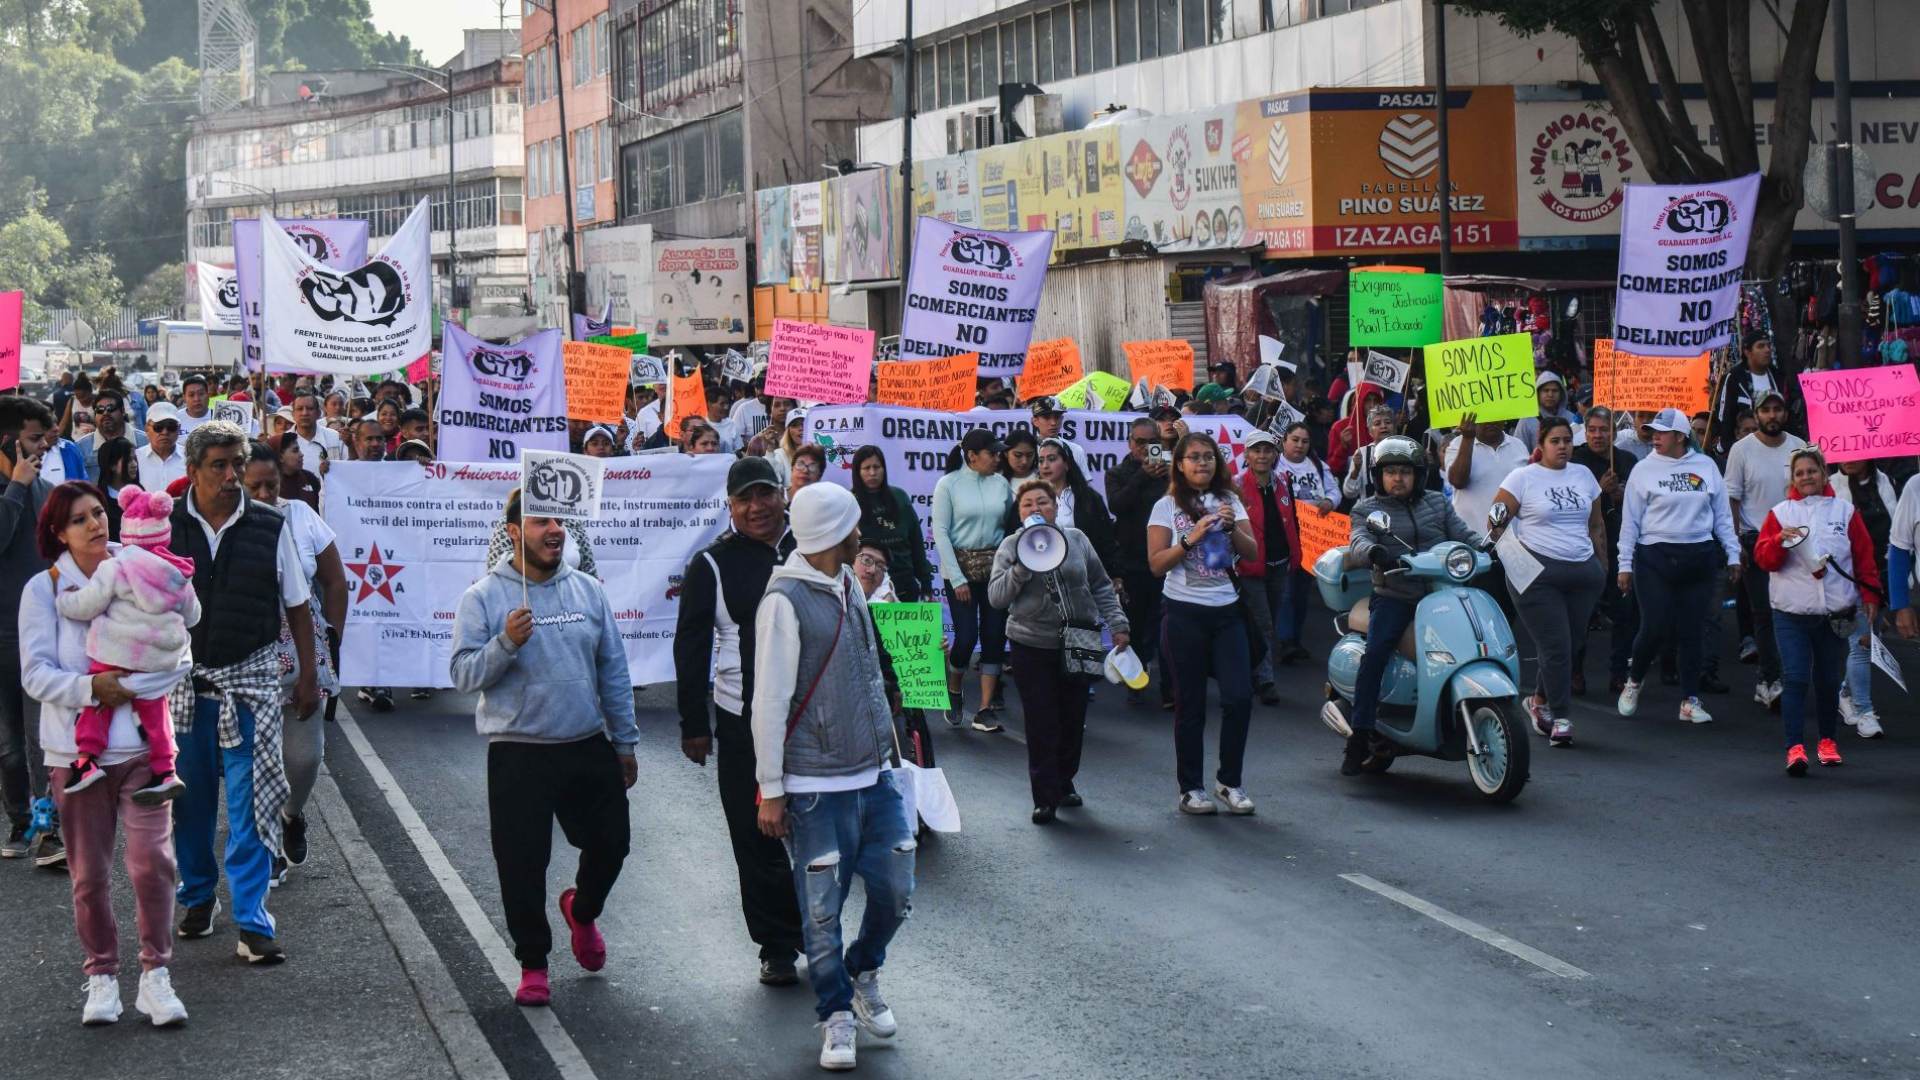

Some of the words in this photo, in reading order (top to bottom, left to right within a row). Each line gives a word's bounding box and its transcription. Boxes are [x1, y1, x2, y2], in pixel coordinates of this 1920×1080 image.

[1267, 99, 1290, 114] PASAJE
[1530, 112, 1633, 175] MICHOACANA
[1195, 164, 1238, 192] SUKIYA
[1258, 203, 1276, 218] PINO
[1339, 198, 1393, 215] PINO
[1551, 201, 1571, 217] LOS
[1573, 200, 1615, 220] PRIMOS
[1292, 229, 1305, 248] 151
[1335, 226, 1442, 247] IZAZAGA
[1455, 224, 1492, 243] 151
[1658, 239, 1699, 247] GUADALUPE
[719, 248, 736, 260] DE
[1666, 249, 1728, 272] SOMOS
[658, 261, 690, 272] ROPA
[693, 259, 738, 271] CENTRO
[942, 265, 977, 276] GUADALUPE
[948, 280, 1008, 301] SOMOS
[908, 294, 1036, 323] COMERCIANTES
[1679, 299, 1712, 323] NO
[294, 328, 323, 339] FRENTE
[324, 333, 367, 343] UNIFICADOR
[956, 323, 988, 345] NO
[1617, 317, 1737, 347] DELINCUENTE
[307, 340, 318, 348] DE
[329, 344, 369, 353] REPUBLICA
[311, 351, 353, 361] GUADALUPE
[1442, 342, 1506, 377] SOMOS
[881, 363, 921, 377] CASTIGO
[929, 360, 951, 374] PARA
[880, 390, 916, 400] ARMANDO
[1435, 371, 1536, 413] INOCENTES
[479, 391, 533, 414] SOMOS
[1828, 396, 1916, 414] COMERCIANTES
[441, 410, 567, 434] COMERCIANTES
[1233, 429, 1242, 439] V
[488, 438, 516, 459] NO
[1818, 432, 1920, 453] DELINCUENTES
[1087, 452, 1117, 471] NO
[425, 462, 447, 480] 50
[451, 464, 522, 481] Aniversa
[603, 467, 652, 481] ionario
[1670, 473, 1691, 481] THE
[1658, 480, 1690, 489] NORTH
[347, 496, 404, 511] Luchamos
[406, 500, 442, 511] contra
[445, 499, 455, 511] el
[457, 500, 493, 511] estado
[529, 504, 557, 513] GUADALUPE
[623, 499, 691, 511] instrumento
[693, 497, 720, 510] dócil
[360, 516, 389, 527] servil
[392, 516, 409, 527] del
[411, 515, 488, 530] imperialismo,
[630, 518, 640, 529] al
[642, 518, 688, 531] trabajo,
[689, 517, 700, 527] al
[702, 517, 717, 527] no
[593, 536, 608, 546] de
[609, 535, 643, 547] venta.
[355, 547, 364, 559] P
[384, 549, 394, 560] V
[395, 582, 405, 593] A
[352, 609, 360, 617] 28
[361, 609, 370, 617] de
[371, 609, 400, 618] Octubre
[433, 611, 456, 620] com
[614, 608, 644, 620] ueblo
[894, 608, 919, 626] para
[621, 630, 660, 640] residente
[899, 664, 932, 679] López
